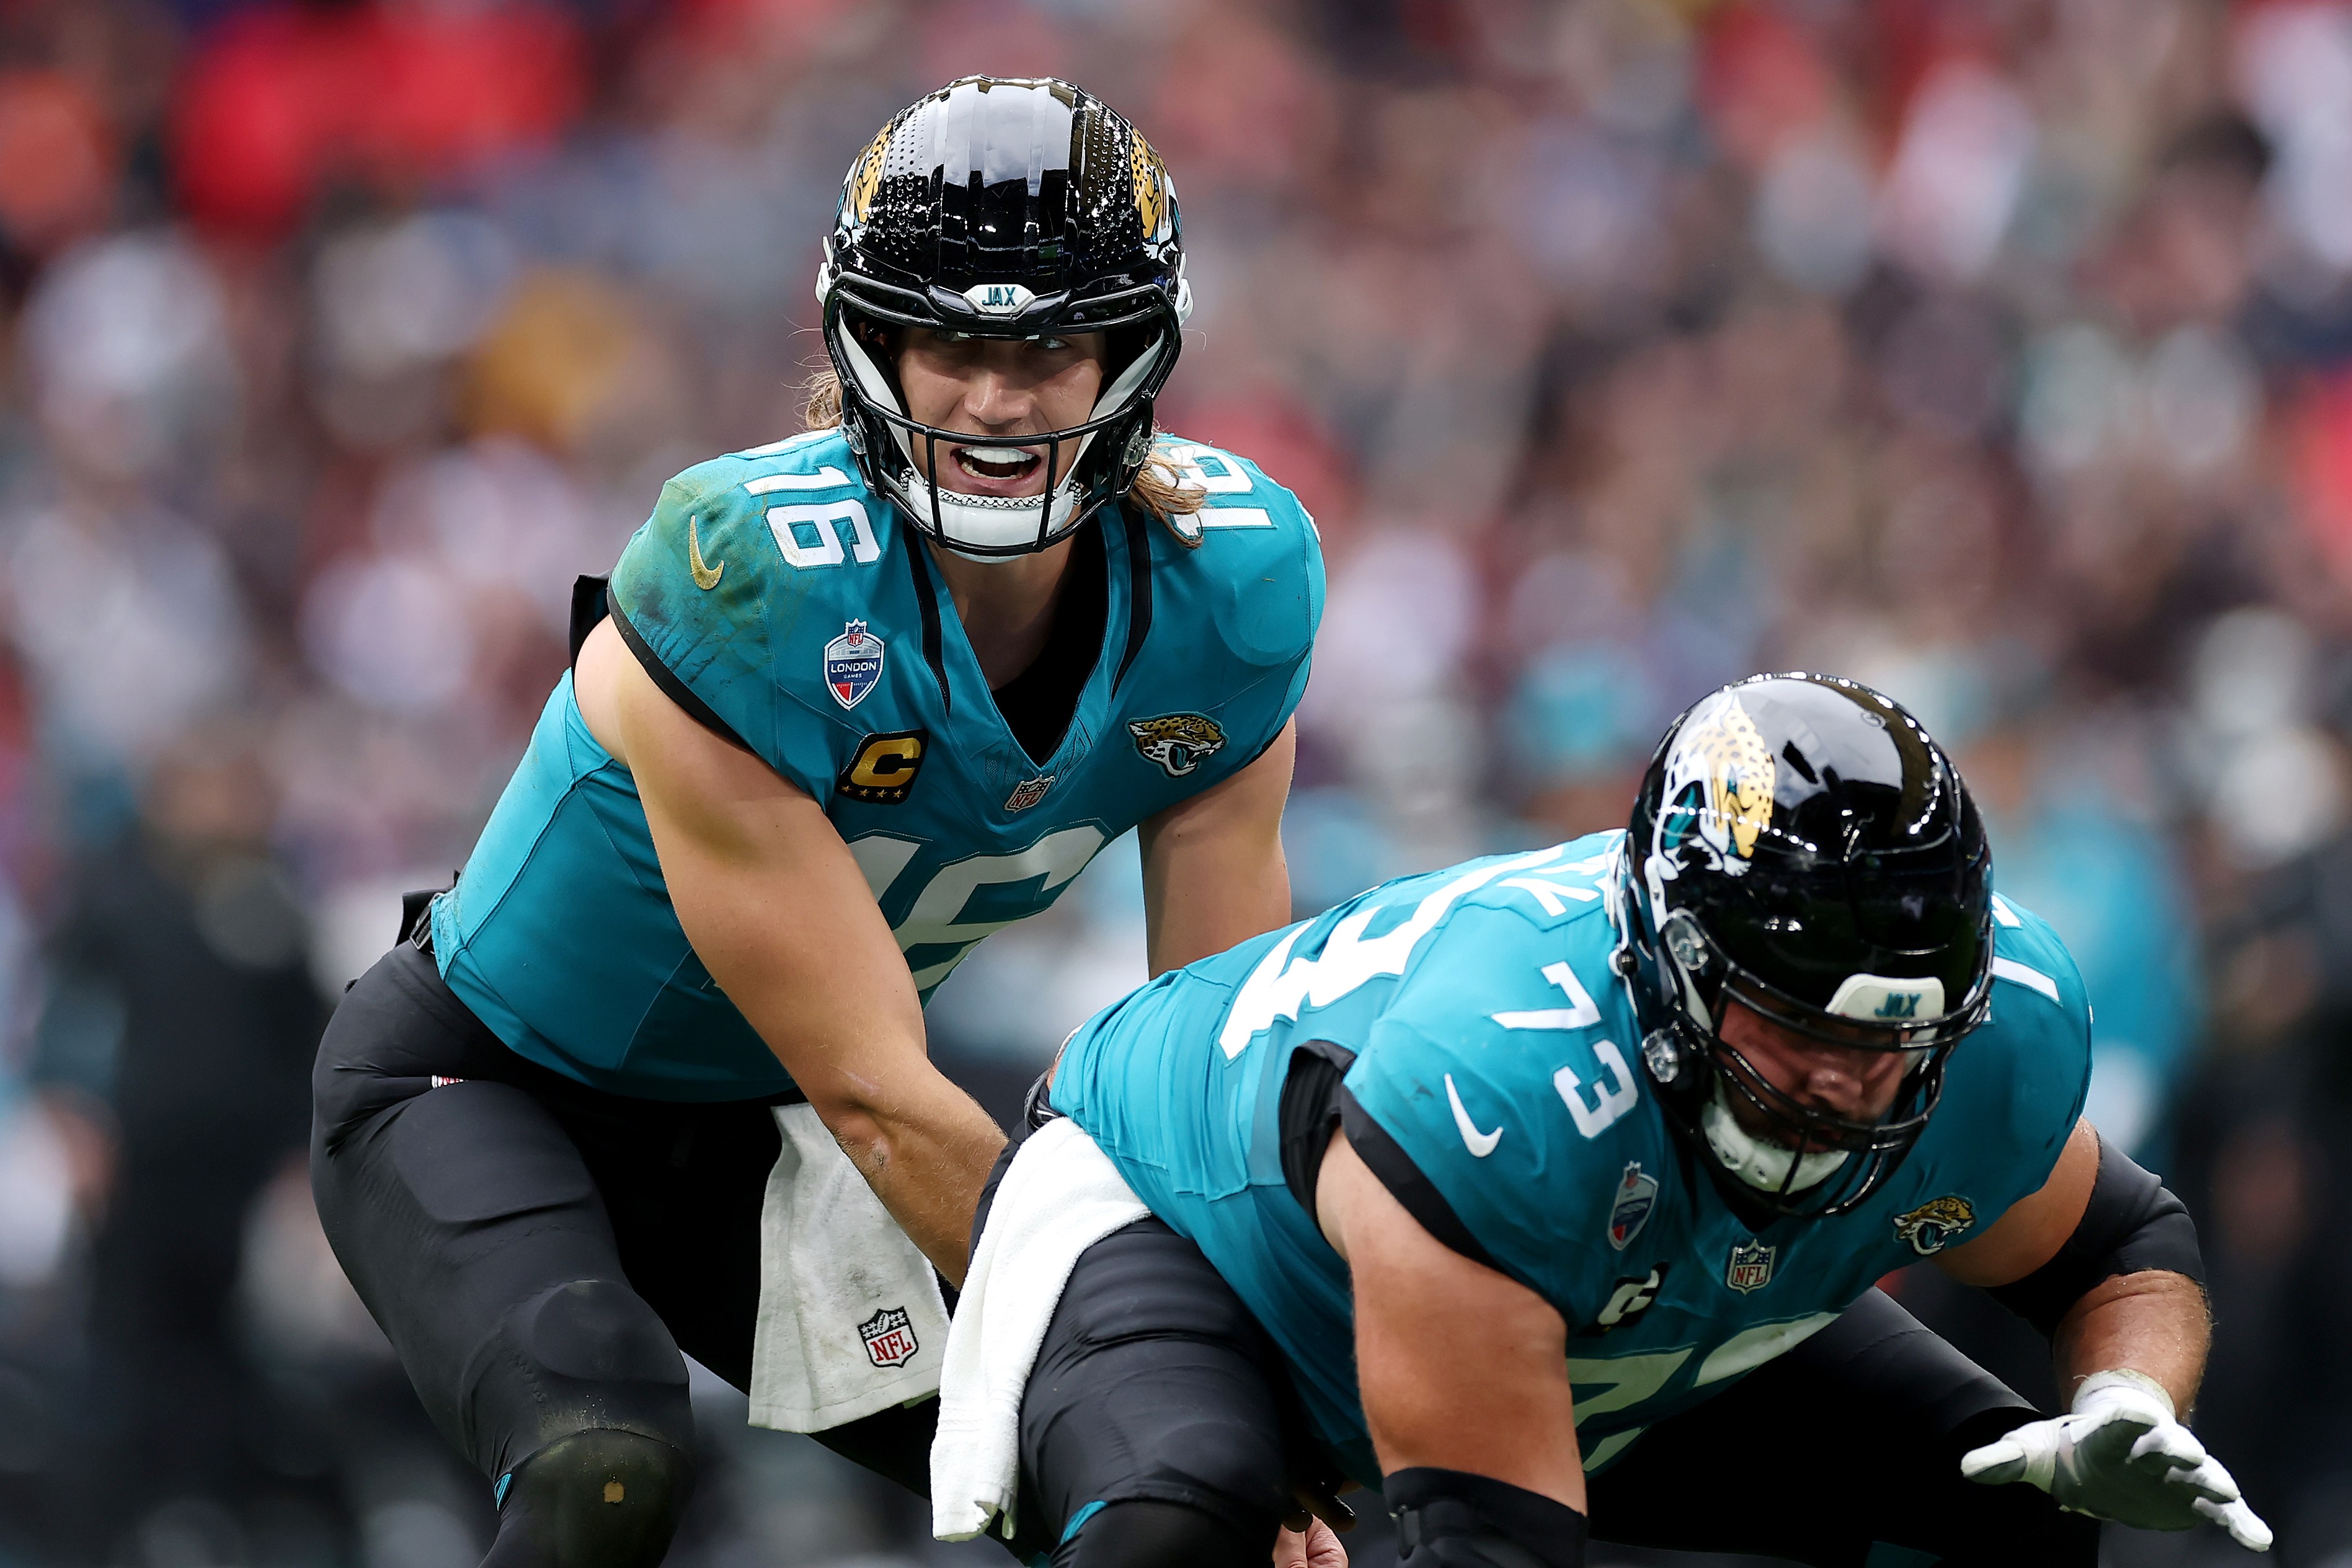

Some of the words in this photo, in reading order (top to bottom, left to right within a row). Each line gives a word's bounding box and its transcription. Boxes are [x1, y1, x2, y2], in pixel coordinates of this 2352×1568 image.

[982, 286, 1016, 306] JAX
[743, 466, 881, 567] 16
[831, 661, 877, 673] LONDON
[851, 737, 921, 786] C
[1010, 792, 1039, 808] NFL
[1491, 962, 1638, 1139] 73
[1734, 1267, 1764, 1285] NFL
[870, 1331, 913, 1362] NFL
